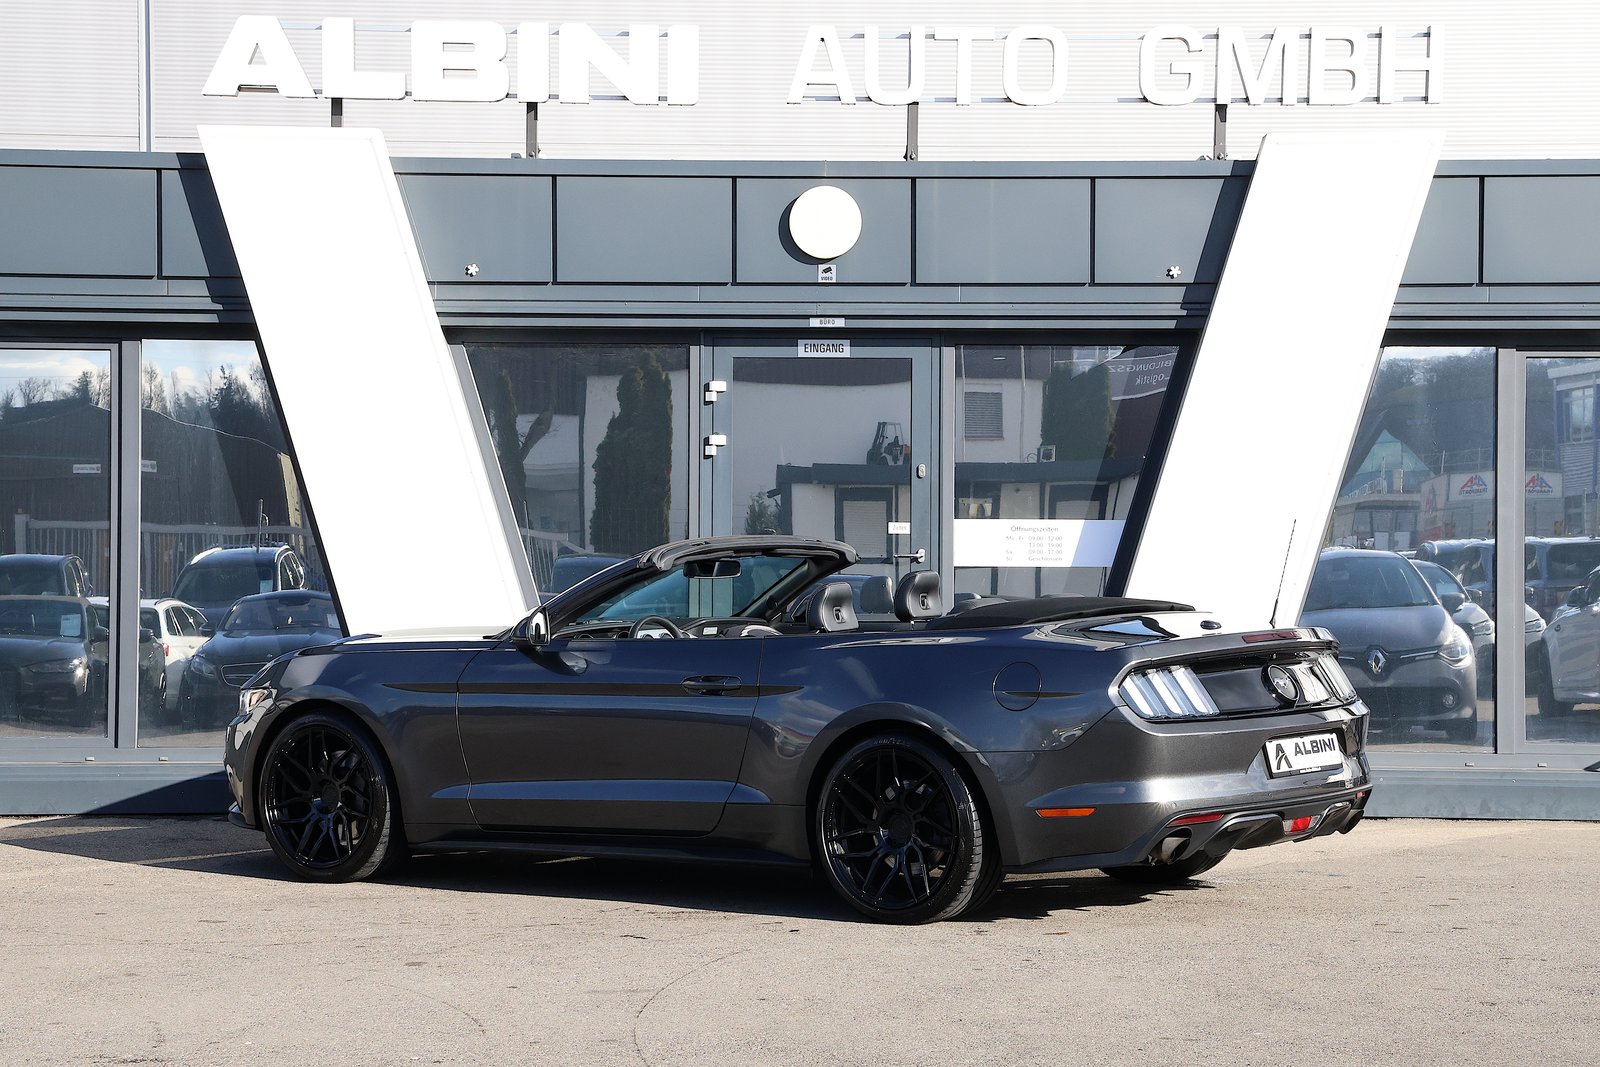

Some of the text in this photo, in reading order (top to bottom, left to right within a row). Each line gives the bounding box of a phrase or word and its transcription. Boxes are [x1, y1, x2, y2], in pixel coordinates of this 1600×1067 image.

[201, 15, 1444, 106] ALBINI AUTO GMBH
[804, 343, 844, 353] EINGANG
[1294, 738, 1336, 756] ALBINI
